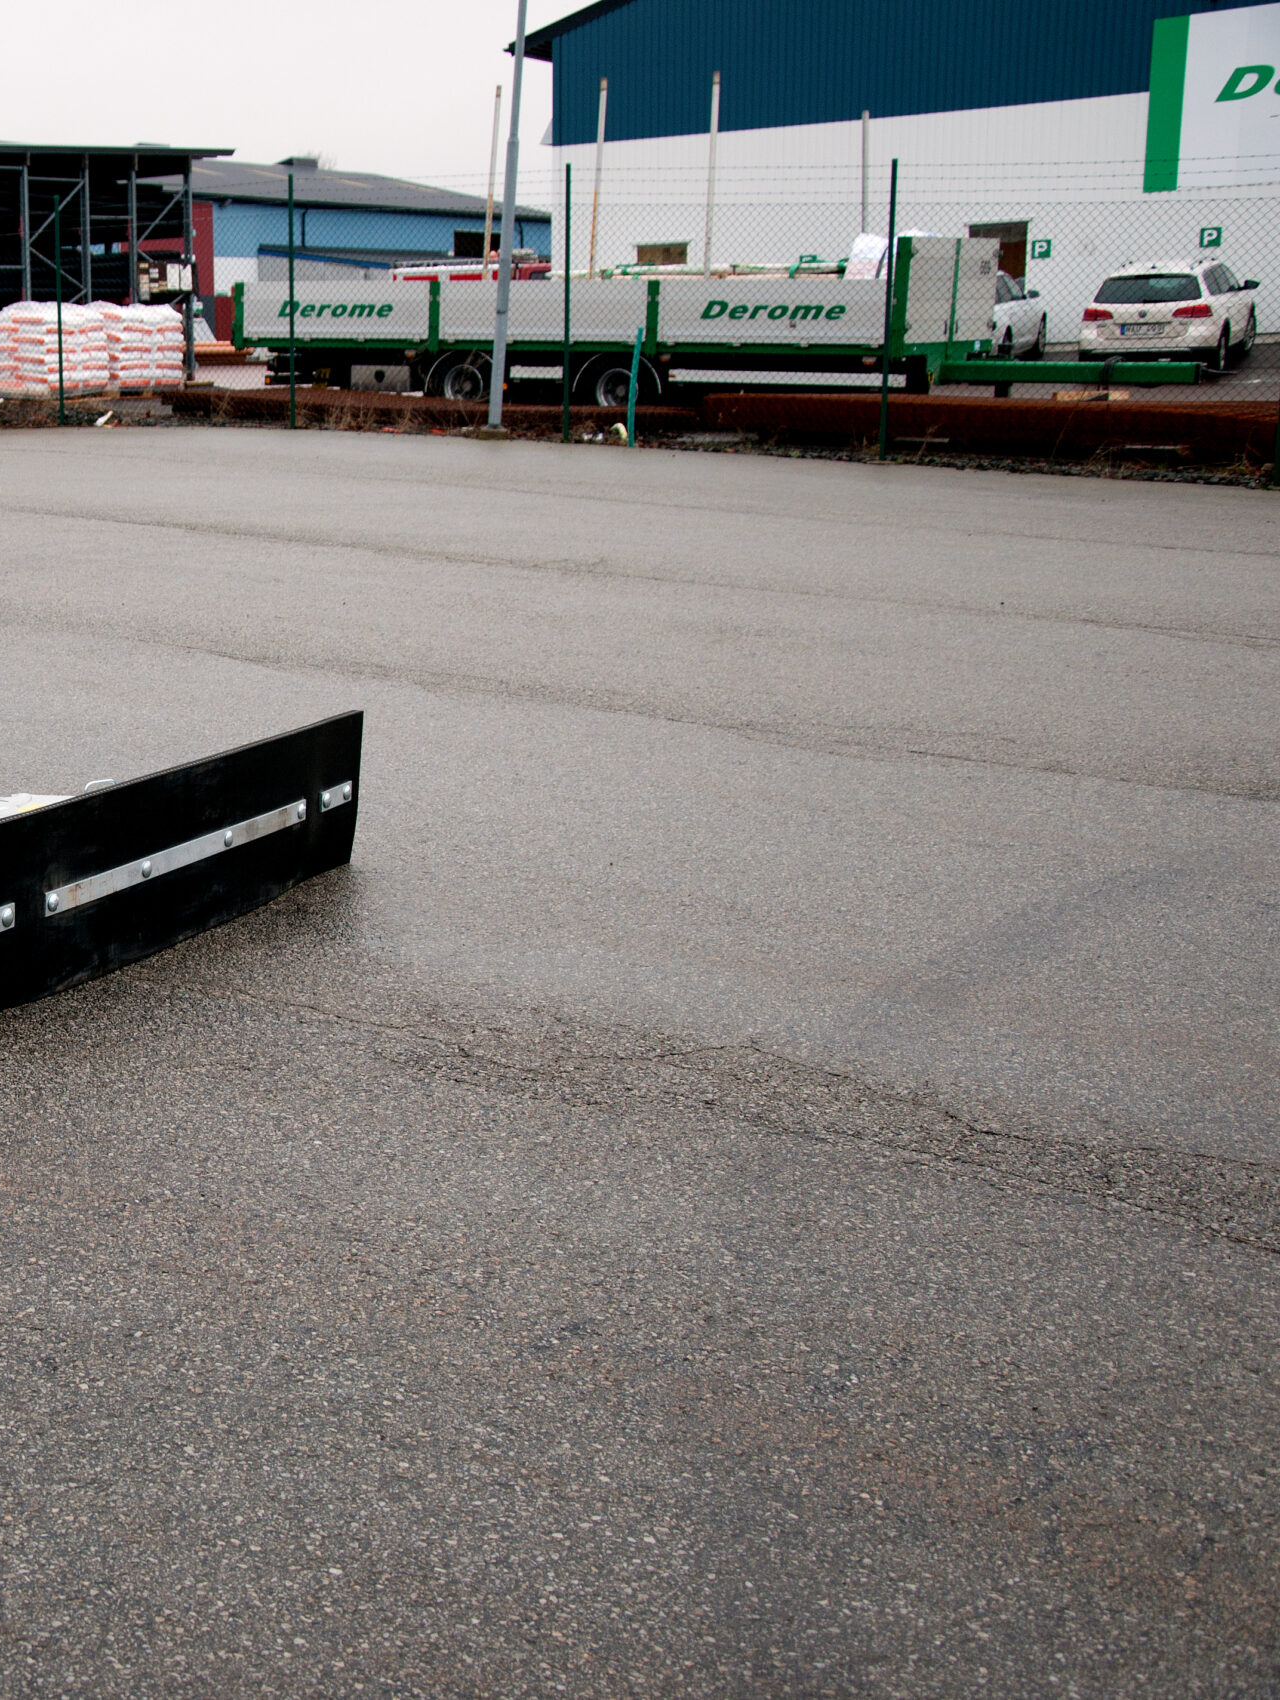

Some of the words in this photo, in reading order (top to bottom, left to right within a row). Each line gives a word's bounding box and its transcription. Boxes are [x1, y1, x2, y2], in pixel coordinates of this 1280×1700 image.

[1214, 64, 1280, 103] D
[1203, 229, 1218, 246] P
[278, 299, 394, 318] Derome
[700, 299, 846, 320] Derome
